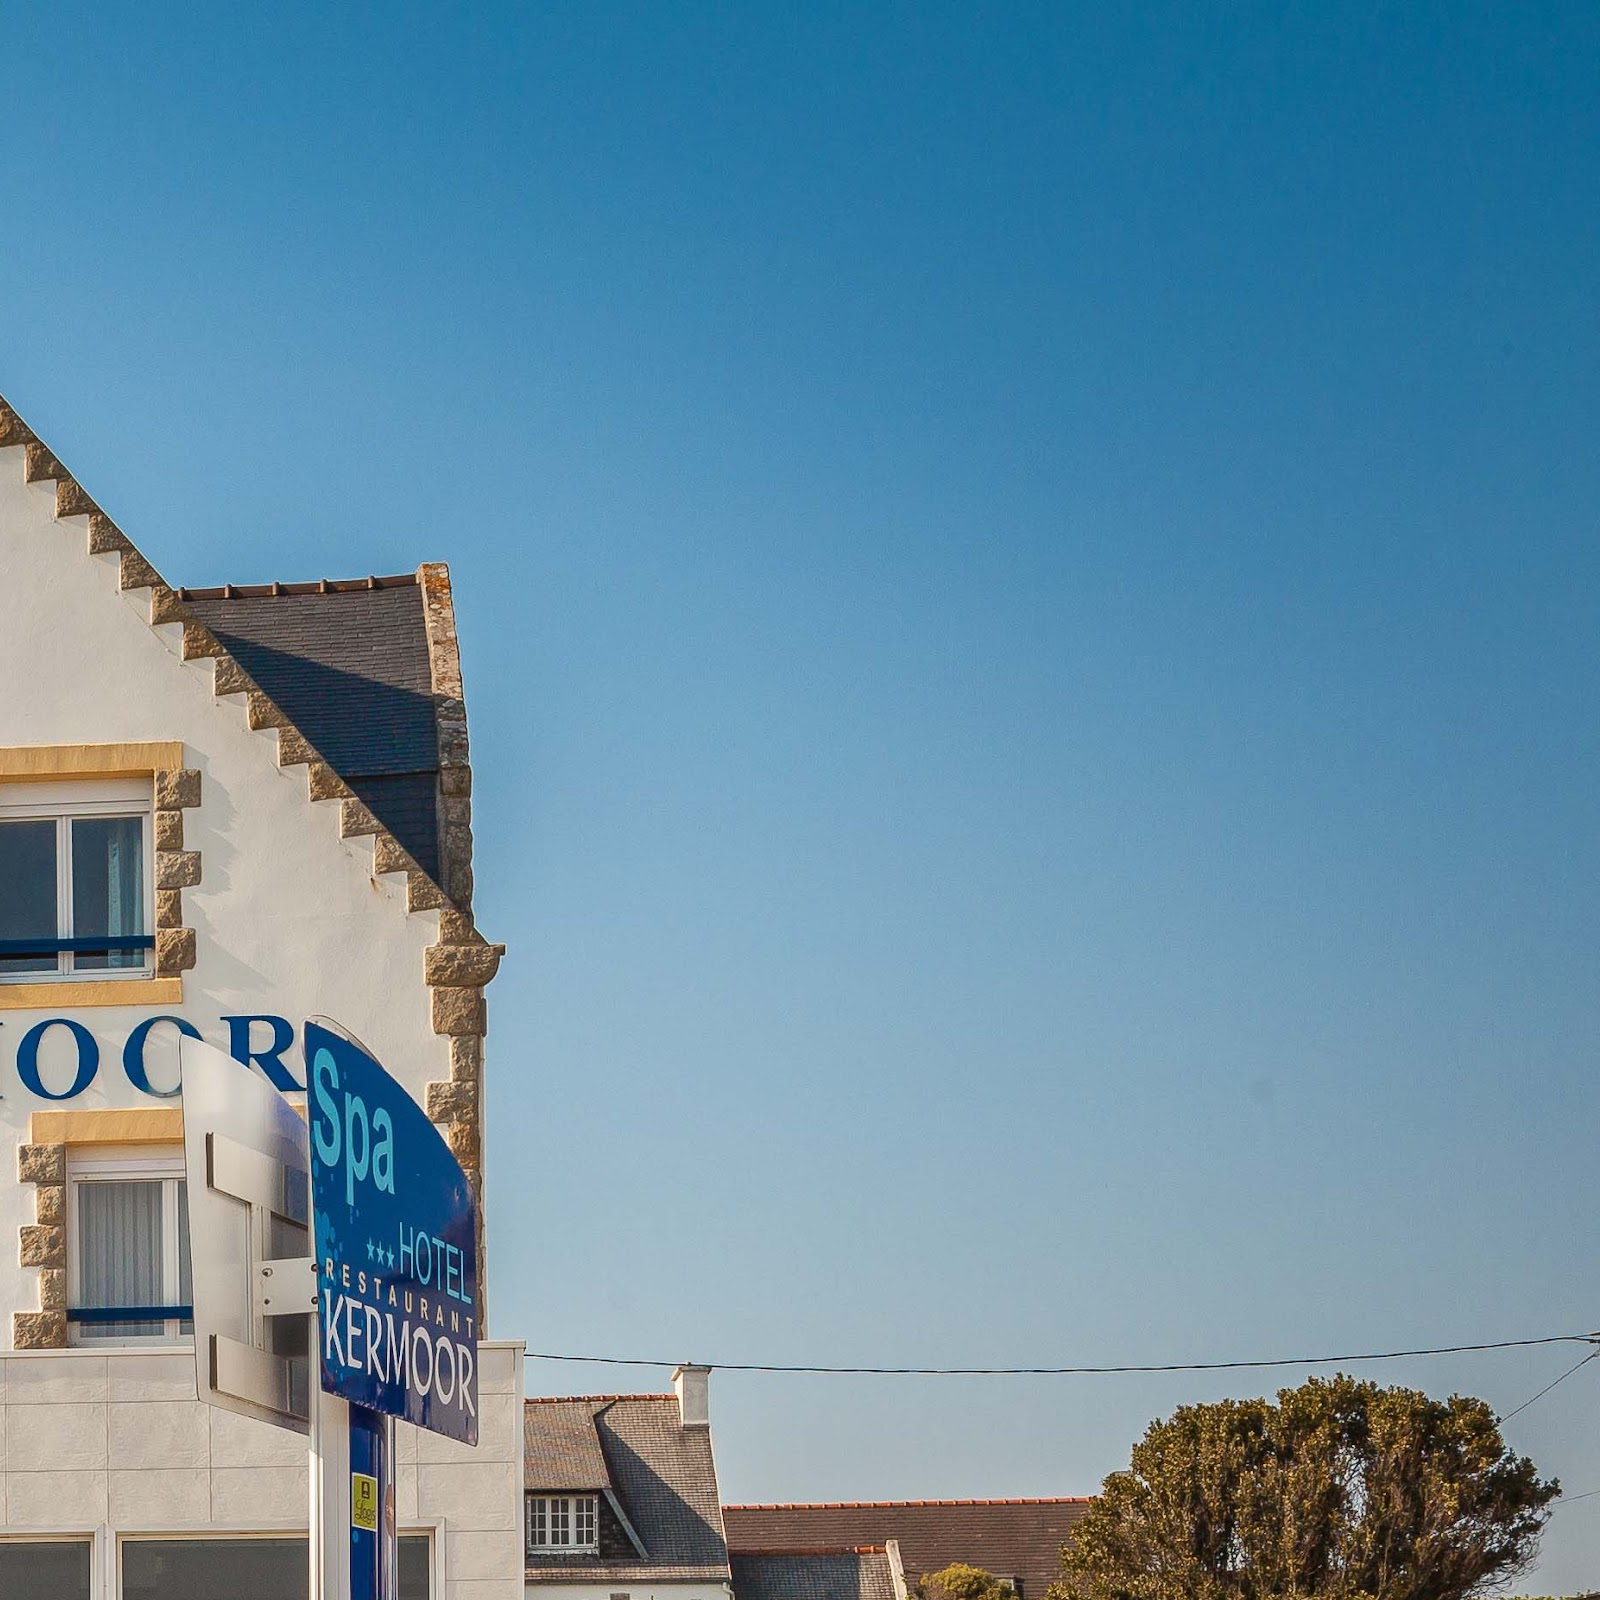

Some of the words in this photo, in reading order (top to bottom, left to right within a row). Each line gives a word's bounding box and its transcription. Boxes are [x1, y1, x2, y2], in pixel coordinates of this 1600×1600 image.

[312, 1047, 396, 1207] Spa
[325, 1257, 474, 1338] RESTAURANT
[399, 1221, 472, 1304] HOTEL
[324, 1288, 476, 1417] KERMOOR
